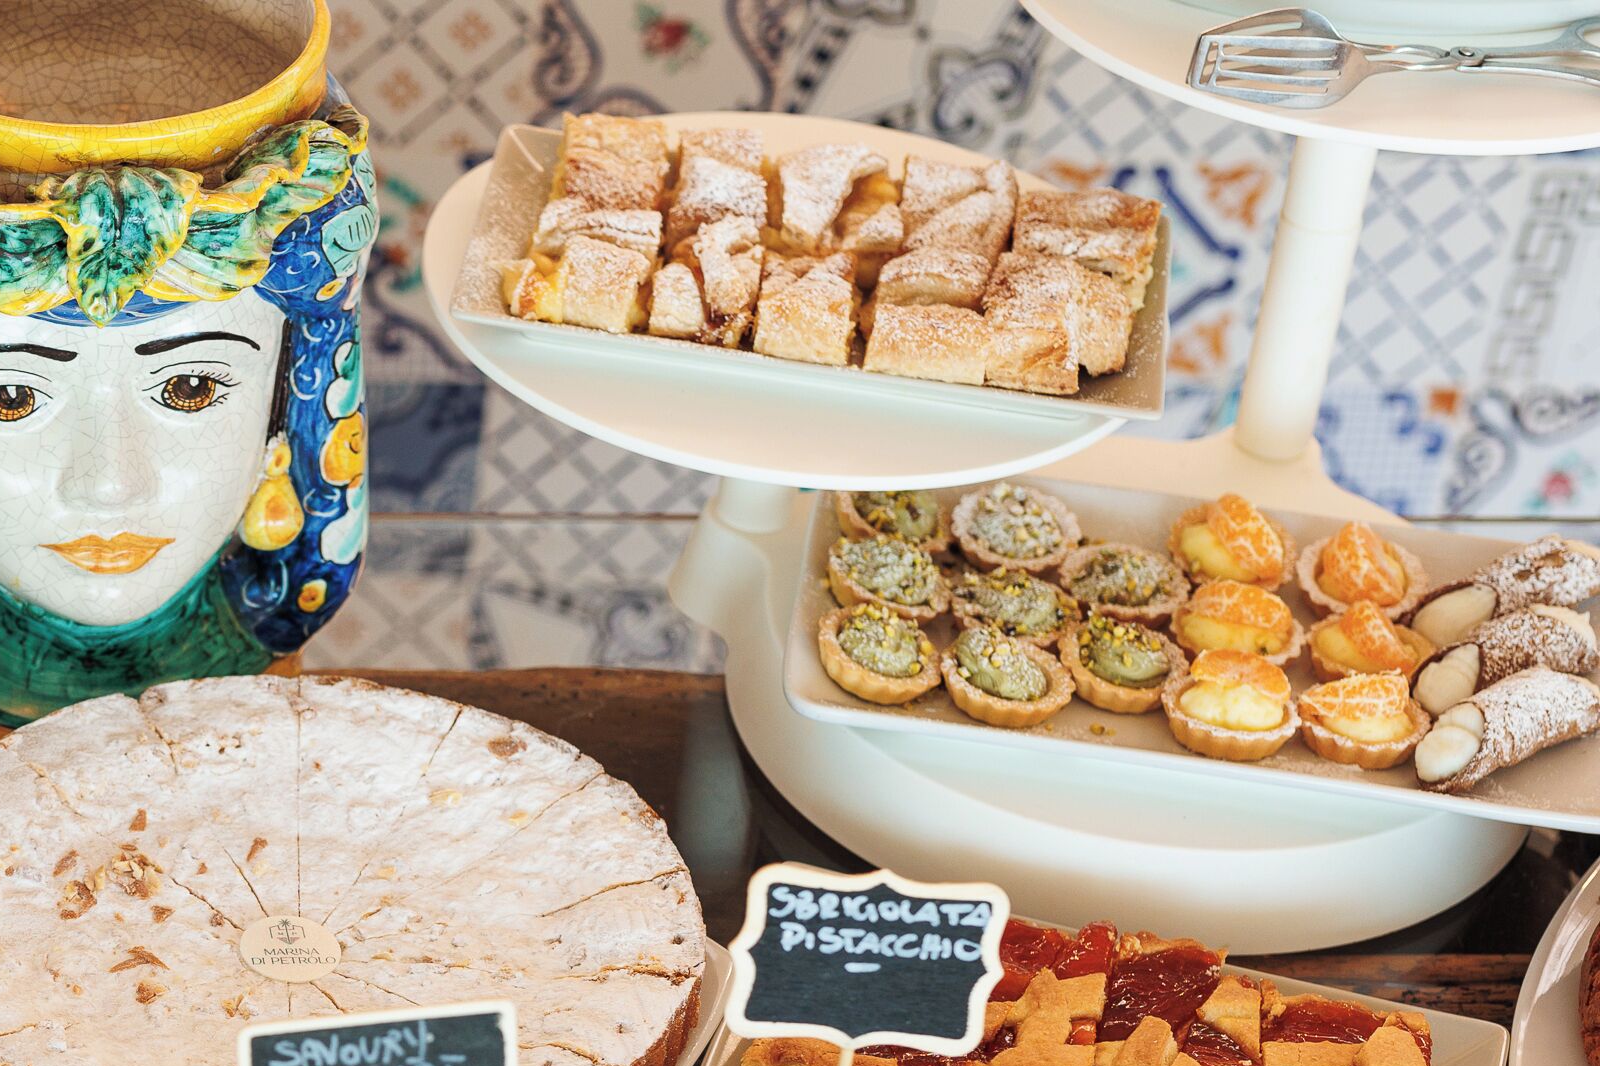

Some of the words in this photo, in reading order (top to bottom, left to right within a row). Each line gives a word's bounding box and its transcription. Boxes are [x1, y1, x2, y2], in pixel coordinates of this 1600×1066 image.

[780, 921, 982, 961] PISTACCHIO
[263, 947, 320, 956] MARINA
[251, 957, 266, 965] DI
[271, 956, 336, 965] PETROLO
